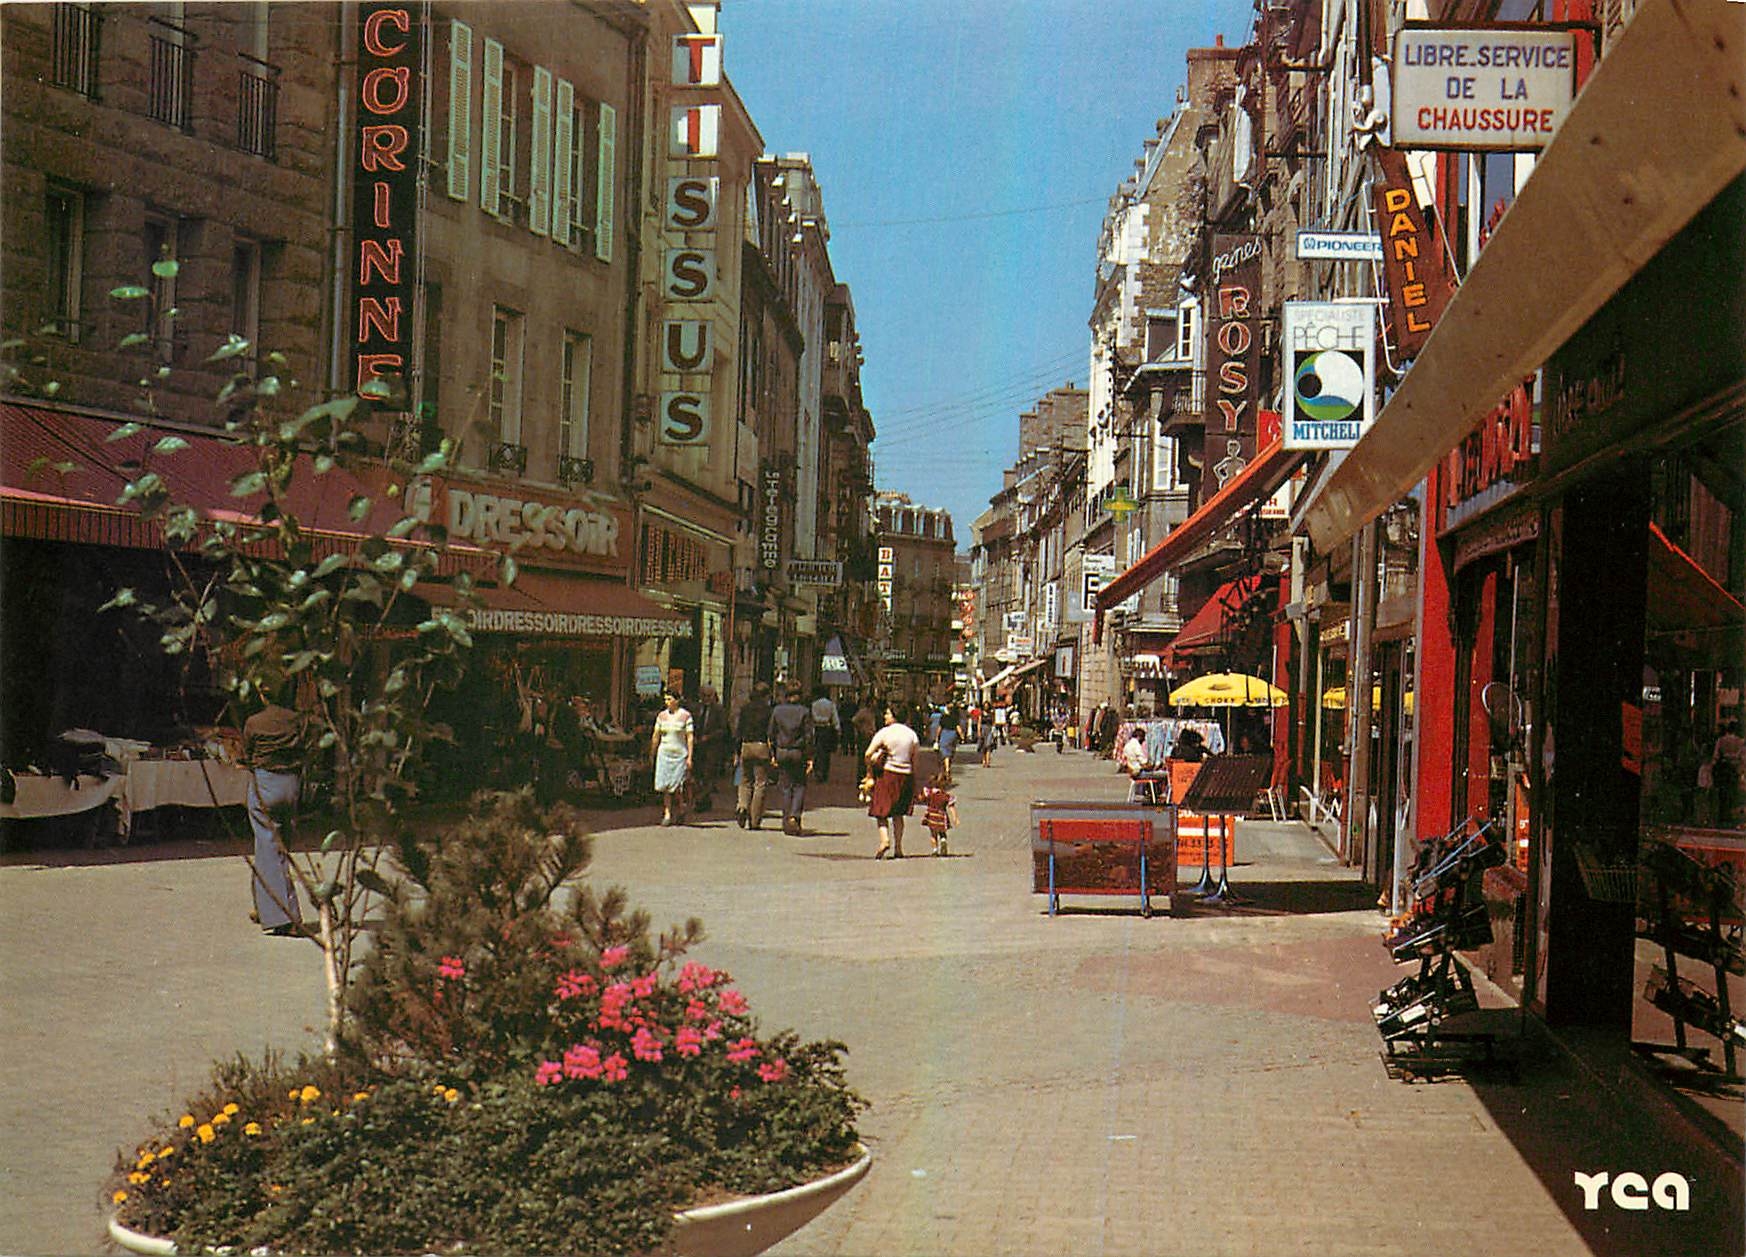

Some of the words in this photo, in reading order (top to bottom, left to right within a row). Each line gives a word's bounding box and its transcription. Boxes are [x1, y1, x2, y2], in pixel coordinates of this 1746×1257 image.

[1417, 107, 1553, 133] CHAUSSURE
[1446, 76, 1476, 99] DE
[1501, 78, 1528, 99] LA
[357, 9, 410, 400] CORINNE
[664, 36, 715, 440] TISSUS
[1316, 241, 1382, 251] PIONEER
[1385, 188, 1431, 332] DANIEL
[1218, 286, 1250, 431] ROSY
